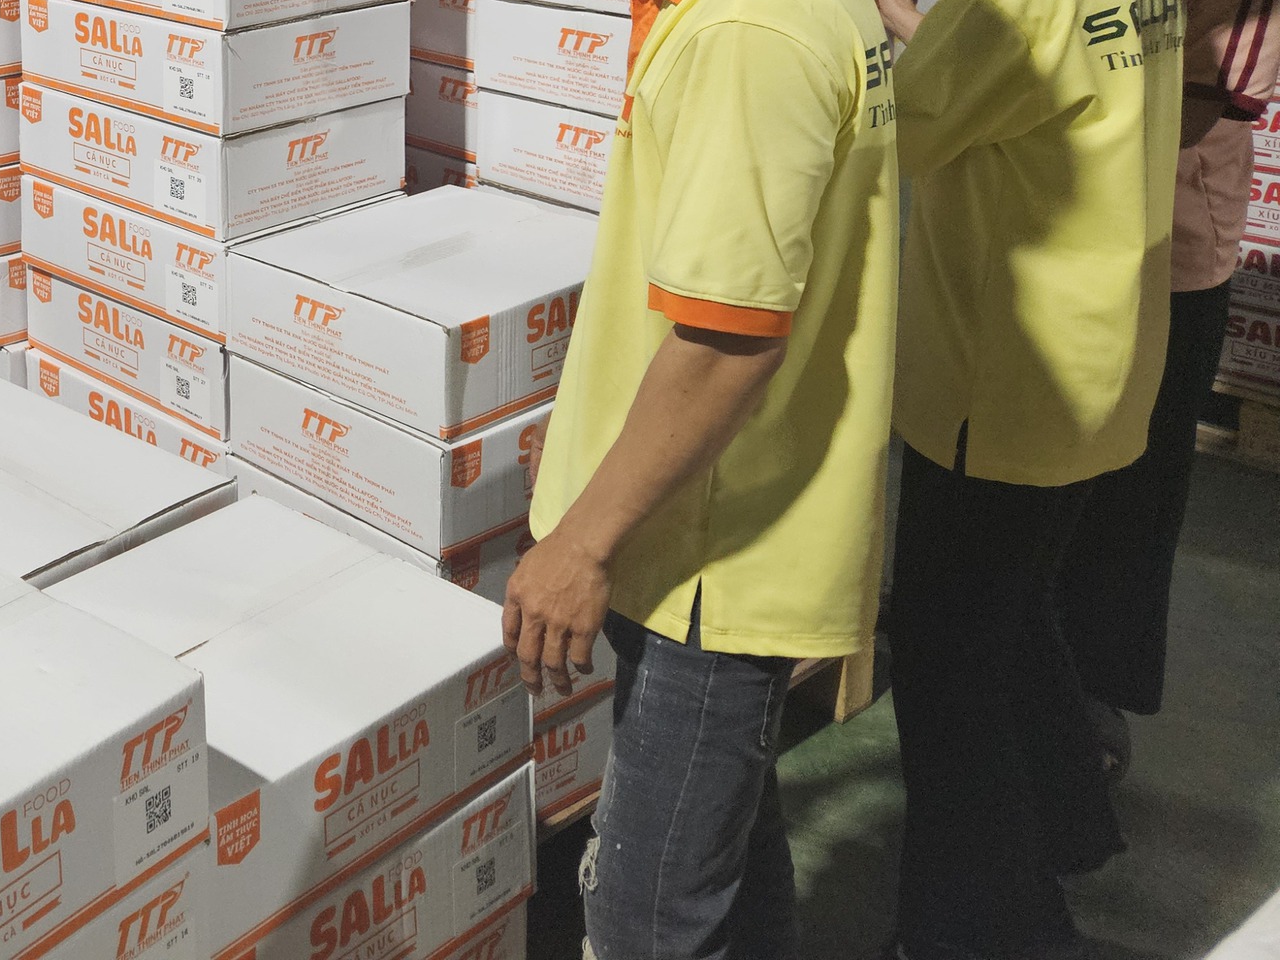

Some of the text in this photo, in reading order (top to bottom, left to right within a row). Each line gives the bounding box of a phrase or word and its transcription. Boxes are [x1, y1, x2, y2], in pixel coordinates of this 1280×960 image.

[75, 12, 143, 58] SALLA
[120, 23, 141, 34] FOOD
[293, 29, 337, 58] TTP
[558, 27, 610, 54] TTP
[167, 33, 204, 58] TTP
[1101, 50, 1144, 72] Tin
[69, 107, 137, 156] SALLA
[113, 120, 135, 134] FOOD
[556, 122, 606, 150] TTP
[161, 136, 200, 162] TTP
[287, 131, 329, 162] TTP
[83, 206, 152, 261] SALLA
[129, 223, 151, 238] FOOD
[176, 242, 215, 270] TTP
[78, 293, 145, 350] SALLA
[121, 311, 143, 327] FOOD
[294, 294, 343, 327] TTP
[168, 334, 205, 363] TTP
[88, 391, 158, 447] SALLA
[133, 411, 156, 430] FOOD
[302, 407, 349, 442] TTP
[393, 702, 427, 732] FOOD
[121, 705, 188, 781] TTP
[534, 723, 586, 764] ALLA
[314, 719, 430, 813] SALLA
[23, 777, 72, 818] FOOD
[116, 879, 185, 960] TTP
[308, 865, 427, 960] SALLA
